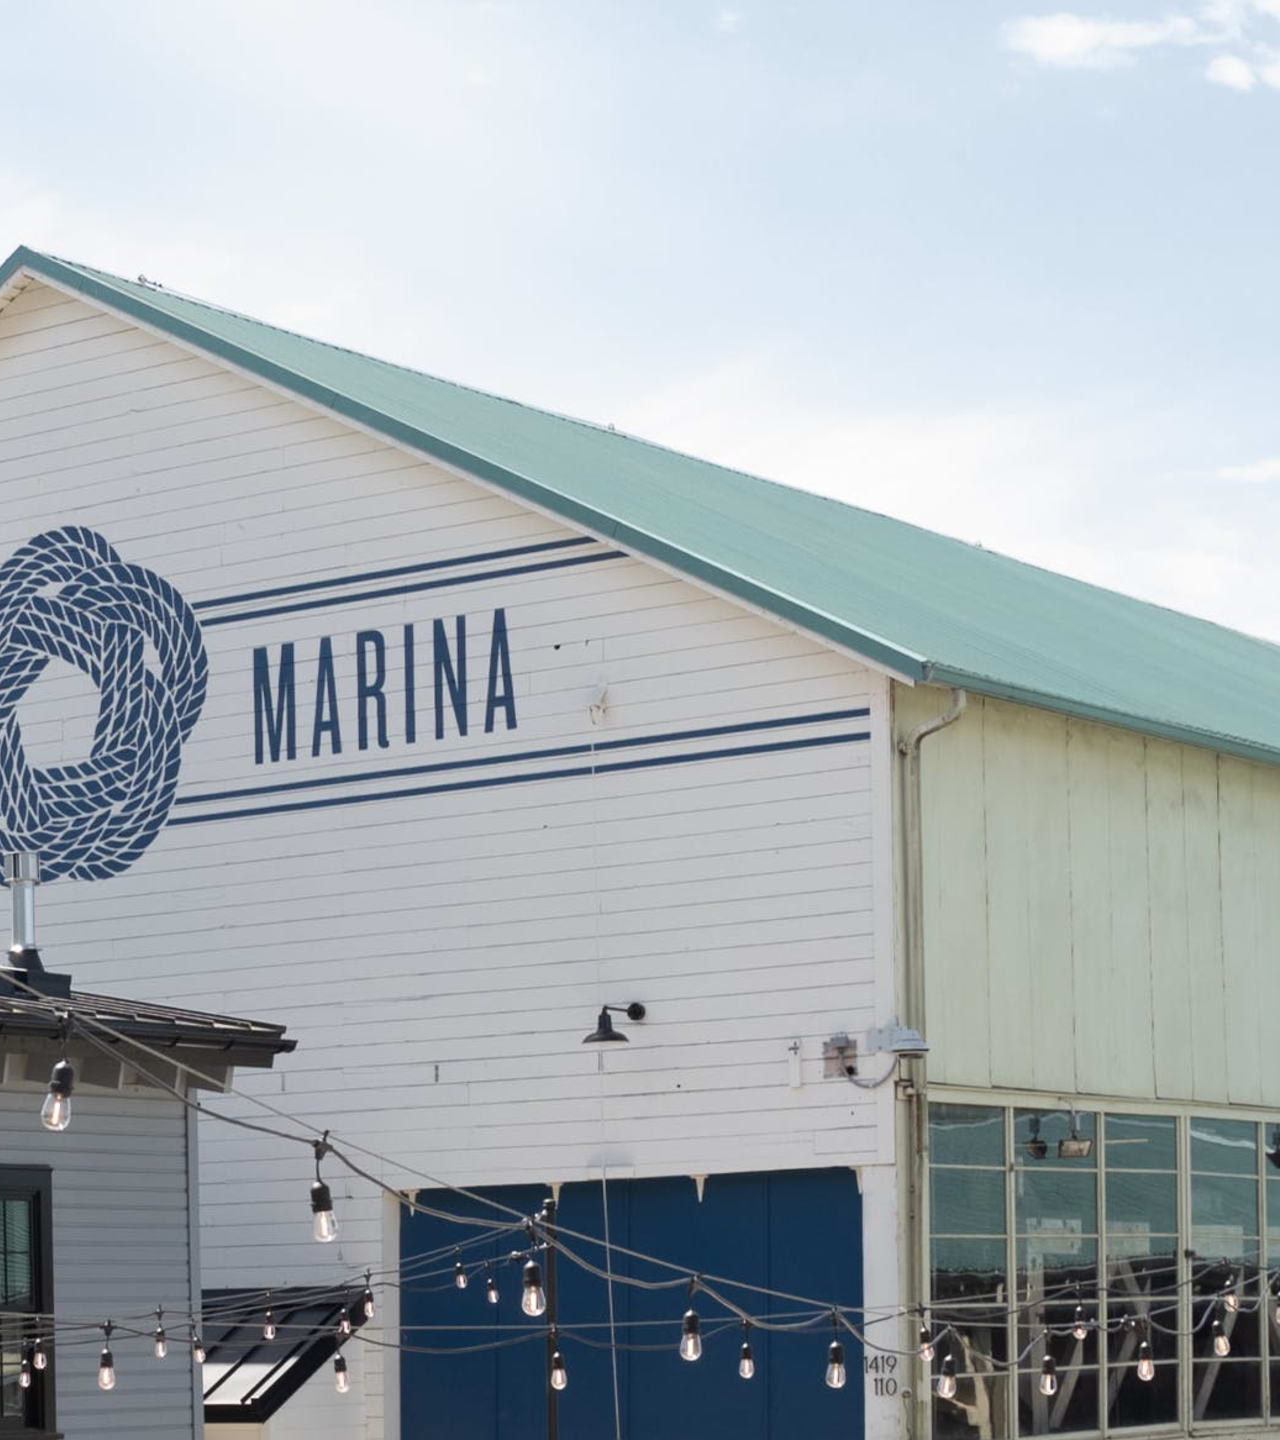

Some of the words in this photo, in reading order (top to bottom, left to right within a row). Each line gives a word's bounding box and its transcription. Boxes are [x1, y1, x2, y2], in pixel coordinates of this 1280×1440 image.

[252, 607, 518, 765] MARINA
[863, 1355, 897, 1374] 1419
[874, 1377, 897, 1396] 110
